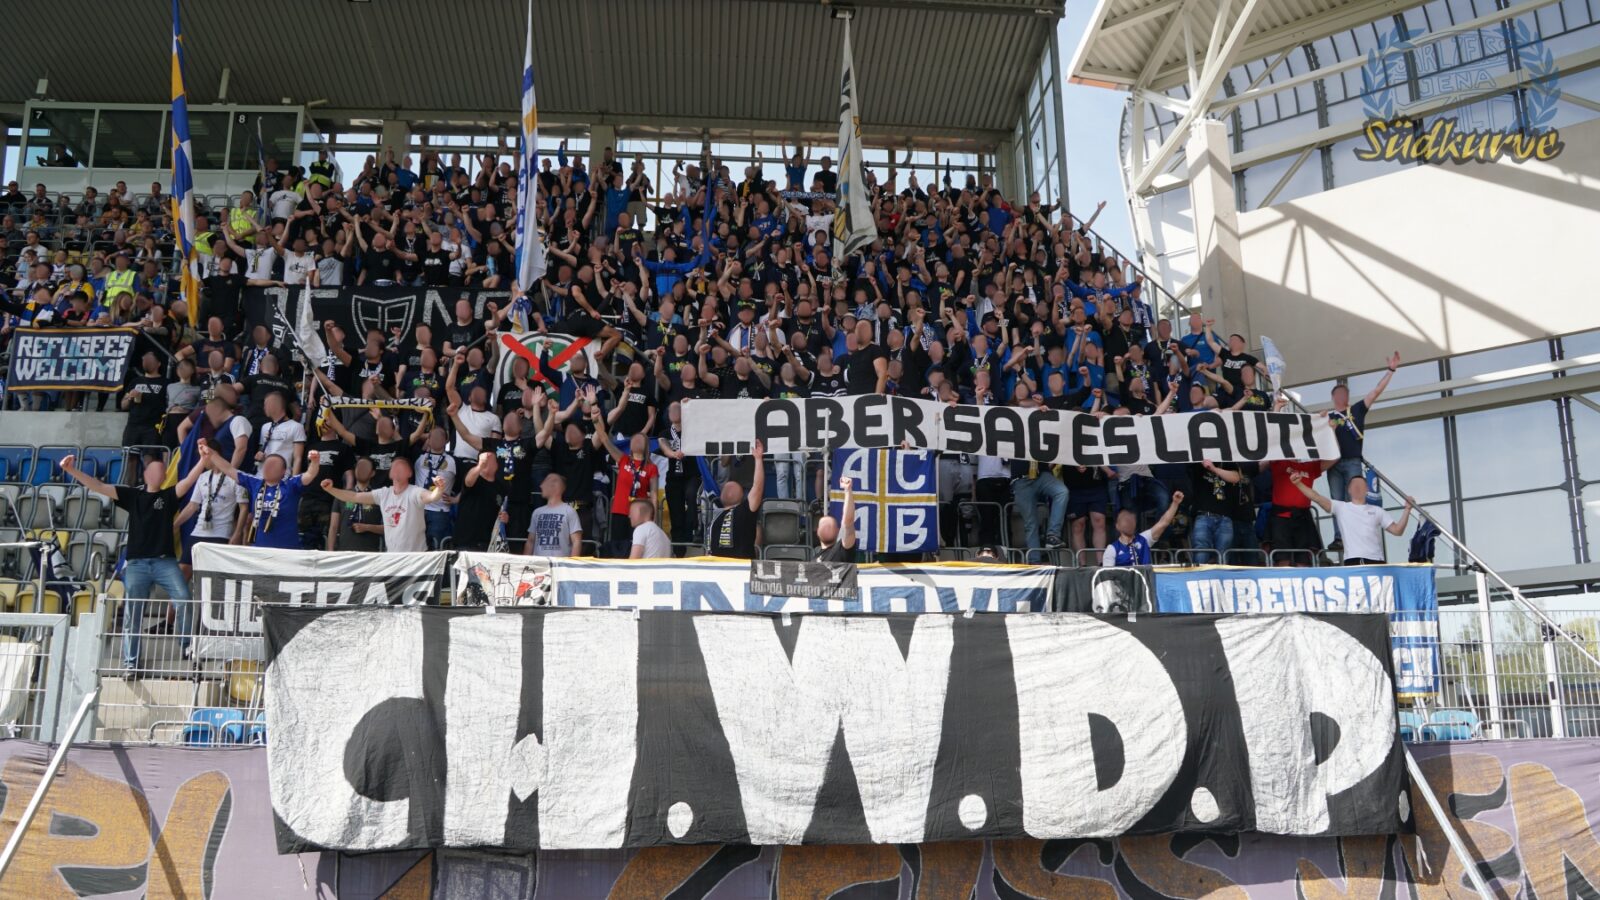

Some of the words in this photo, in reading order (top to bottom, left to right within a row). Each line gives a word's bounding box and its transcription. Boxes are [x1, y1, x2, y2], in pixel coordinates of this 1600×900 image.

[35, 110, 43, 119] 7
[238, 114, 246, 124] 8
[17, 335, 133, 357] REFUGEES
[943, 405, 1060, 463] SAG
[1072, 413, 1141, 466] ES
[1151, 411, 1320, 463] LAUT!
[1186, 575, 1395, 613] UNBEUGSAM
